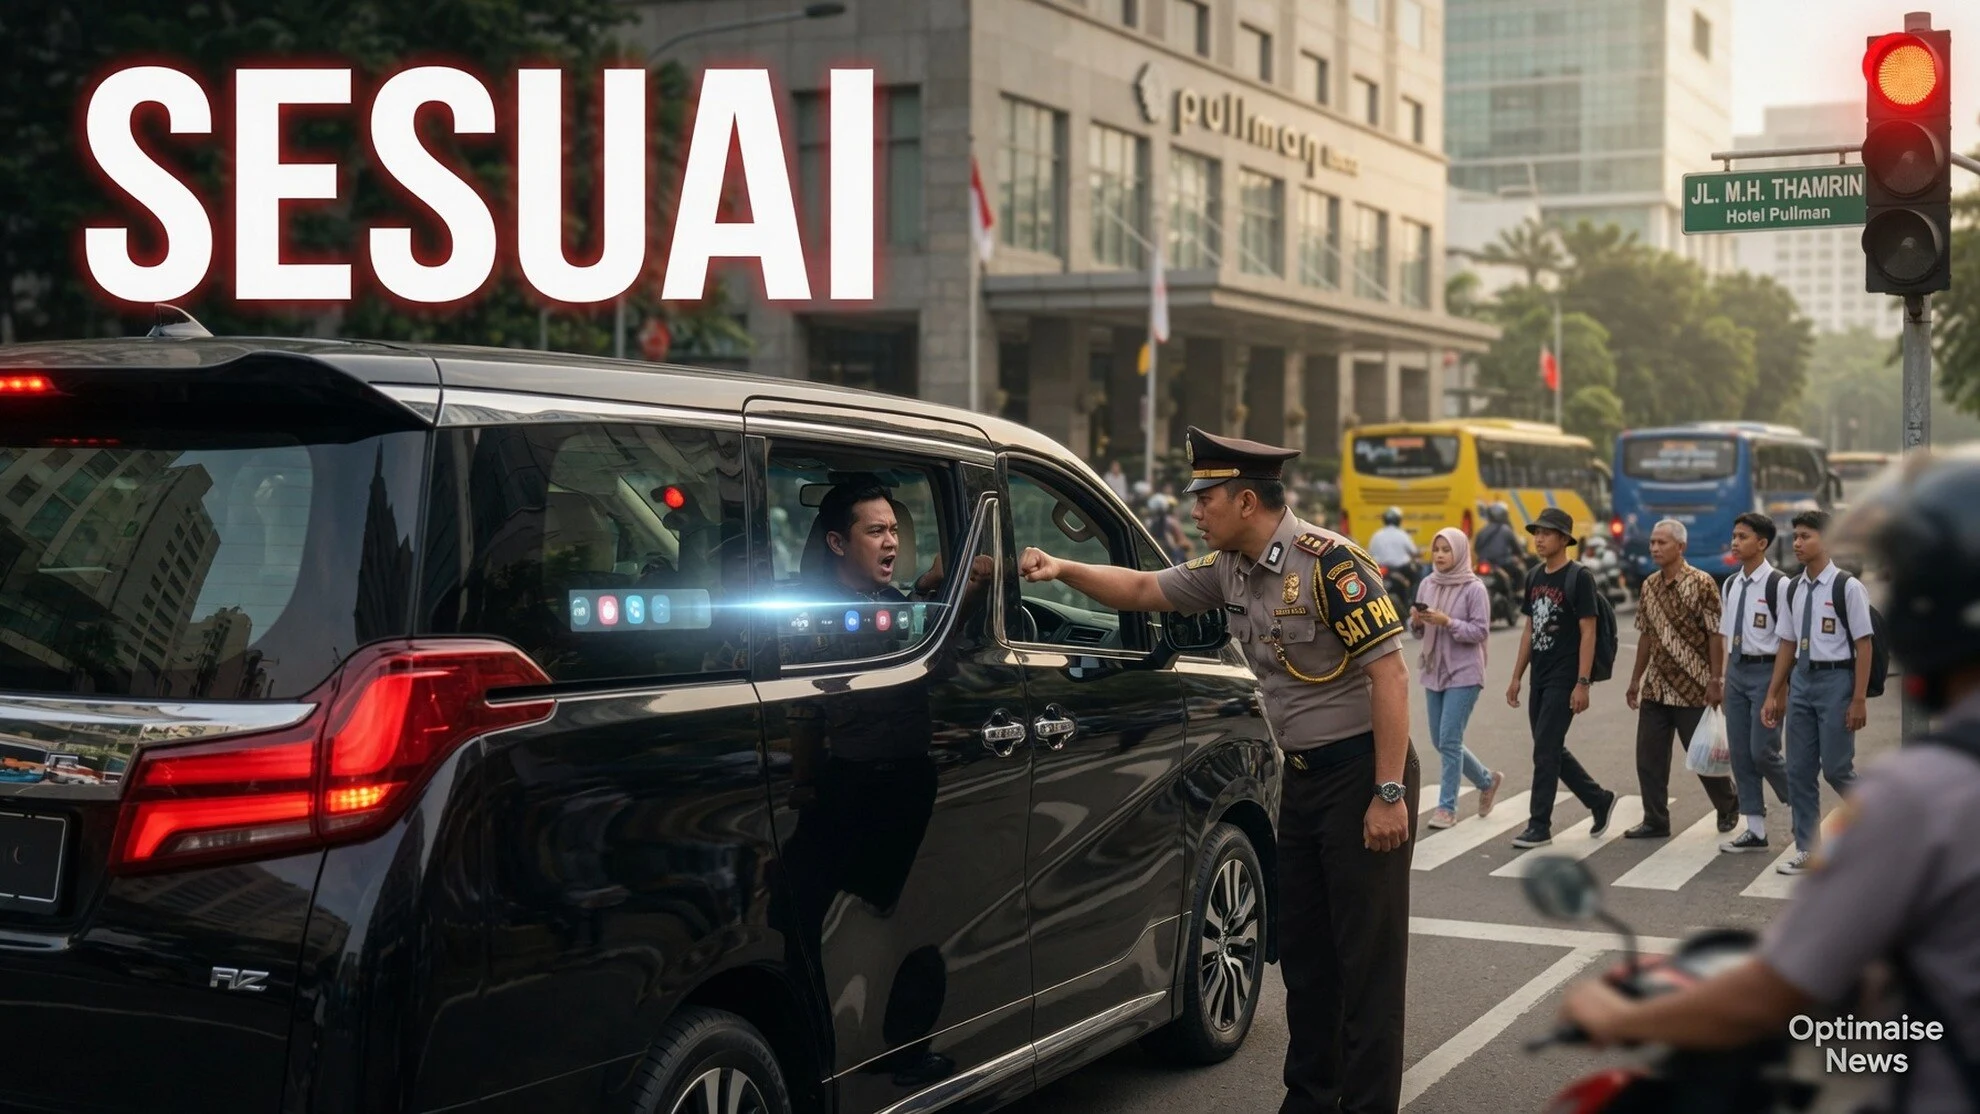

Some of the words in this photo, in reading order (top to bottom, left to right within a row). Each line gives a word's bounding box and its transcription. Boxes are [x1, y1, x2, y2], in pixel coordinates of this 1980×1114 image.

[1691, 182, 1719, 205] JL.
[1725, 179, 1765, 203] M.H.
[1772, 173, 1863, 200] THAMRIN
[1727, 207, 1765, 223] Hotel
[1770, 205, 1831, 222] Pullman
[1335, 607, 1371, 647] SAT
